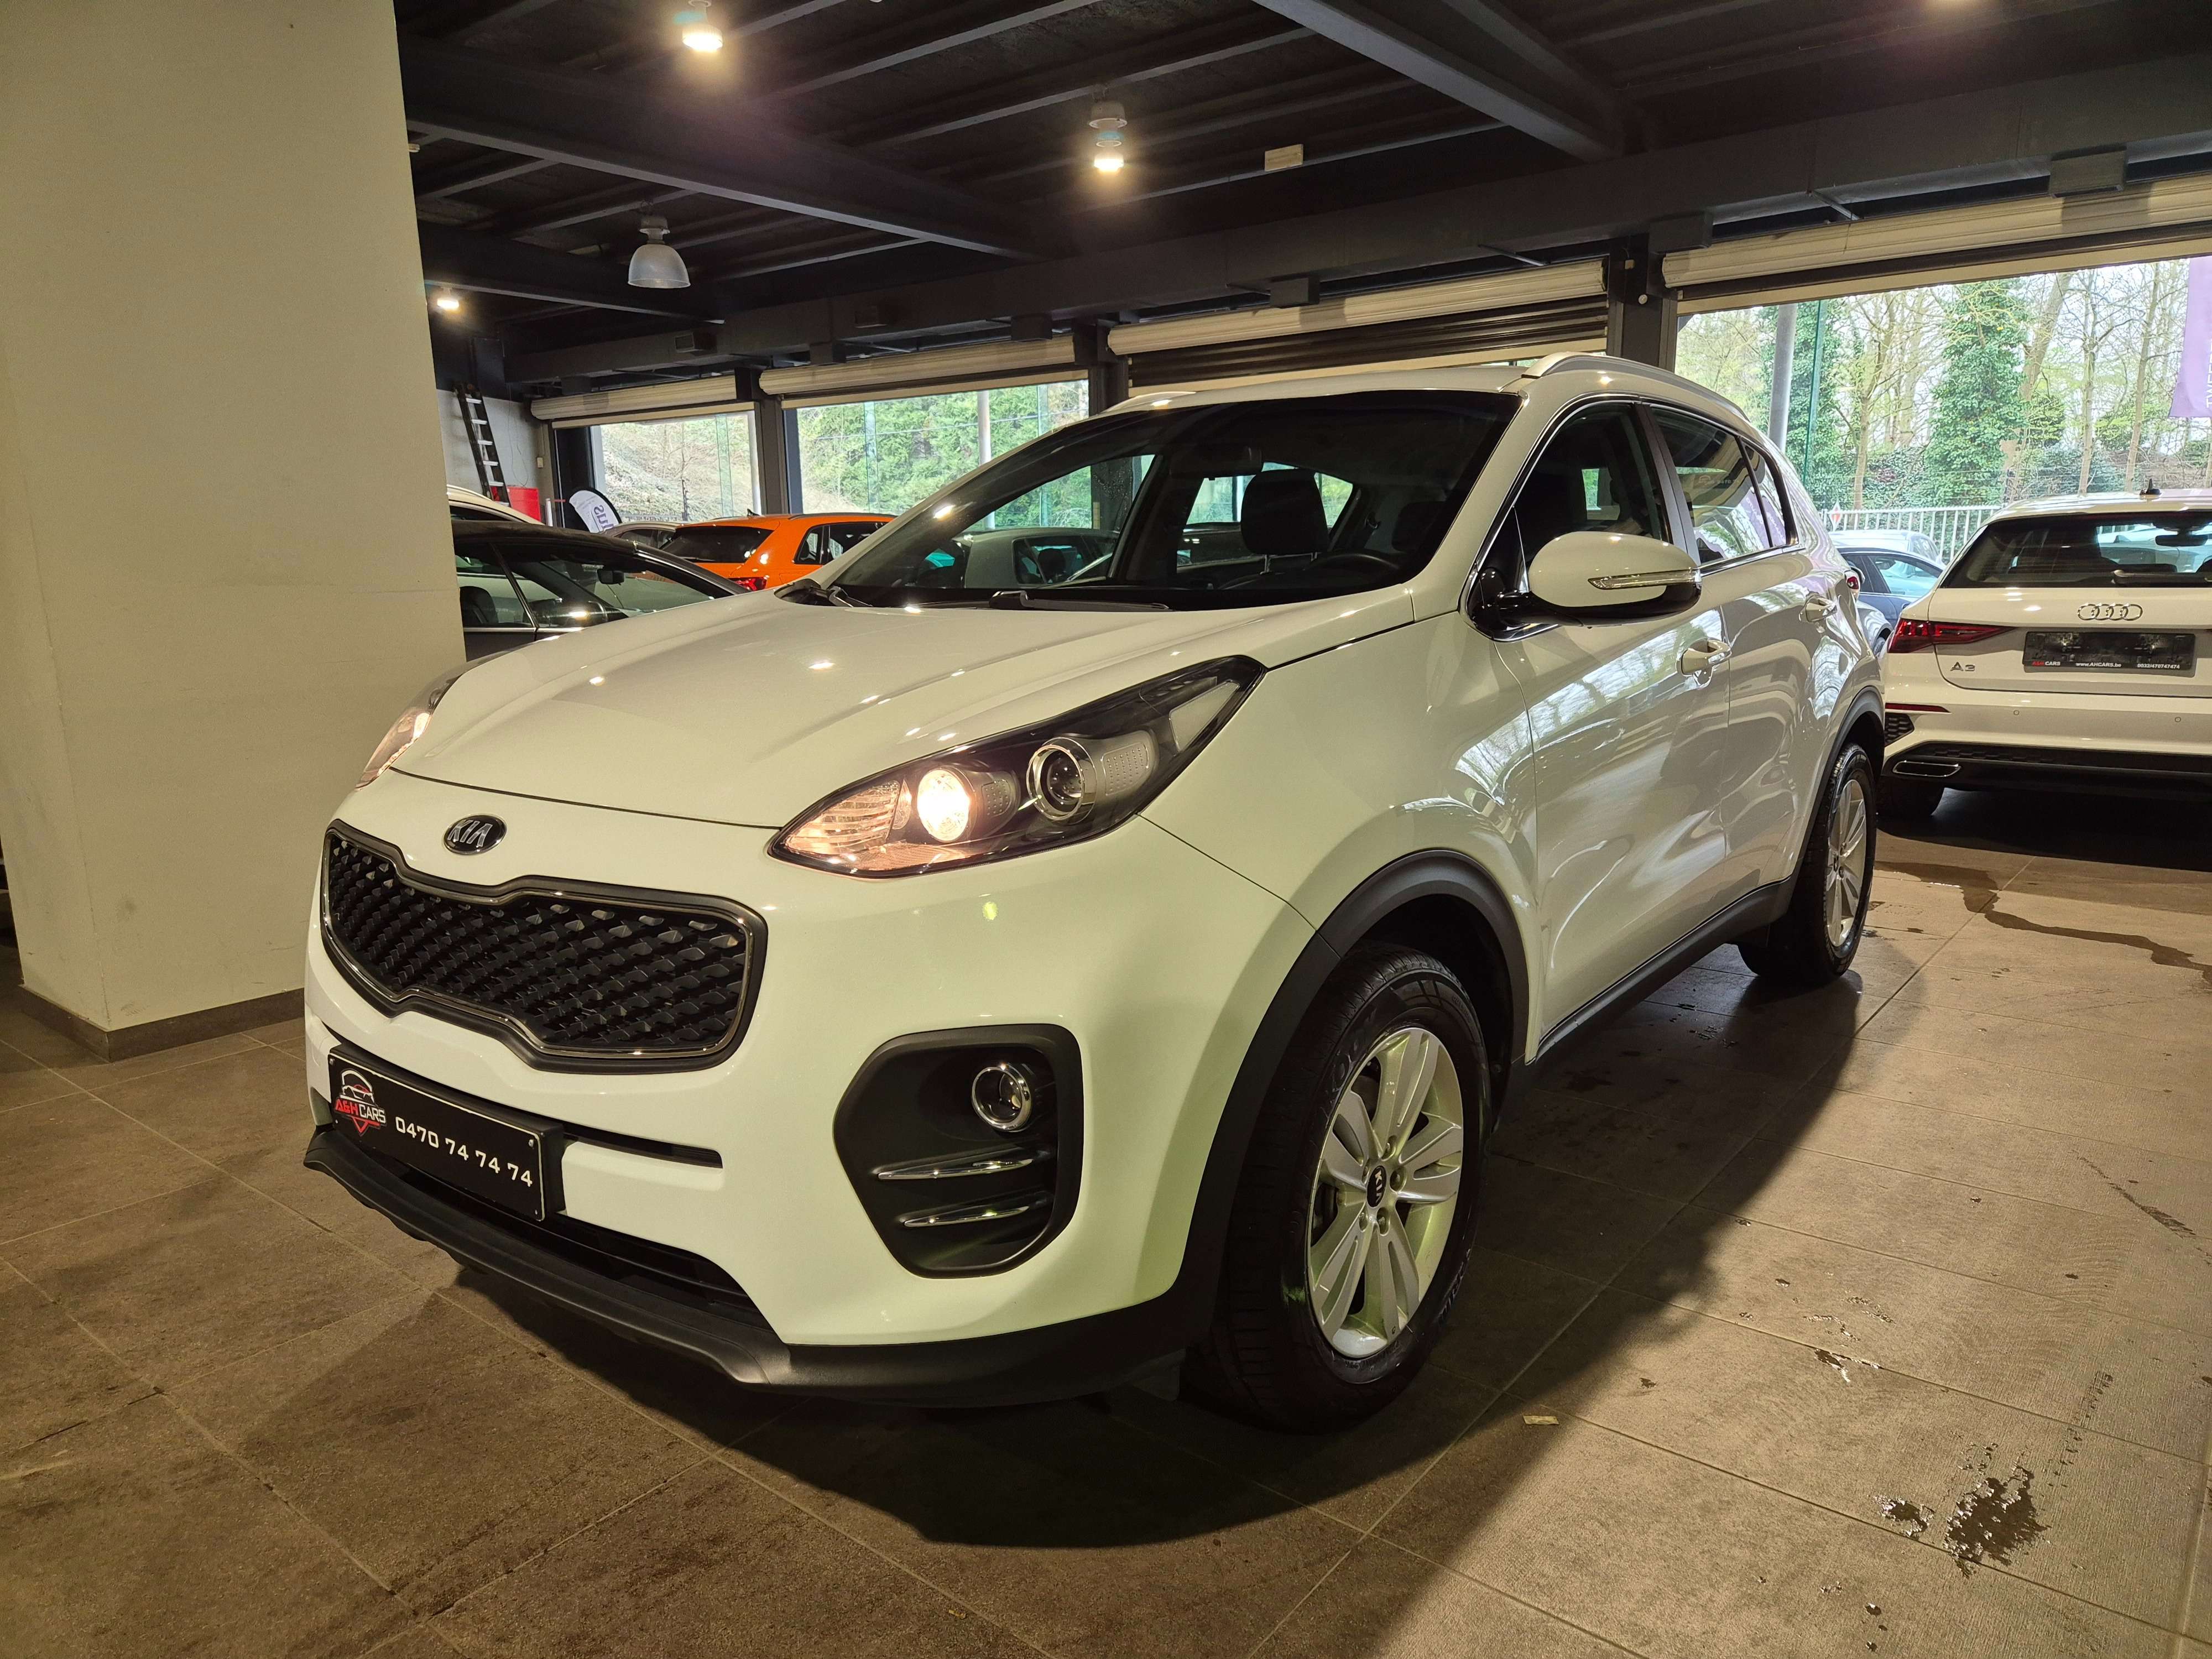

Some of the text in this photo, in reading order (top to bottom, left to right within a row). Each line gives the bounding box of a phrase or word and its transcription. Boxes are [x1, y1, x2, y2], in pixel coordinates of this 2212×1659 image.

[1950, 661, 1975, 672] A3
[447, 819, 493, 847] KIA
[395, 1117, 533, 1187] 0470 74 74 74
